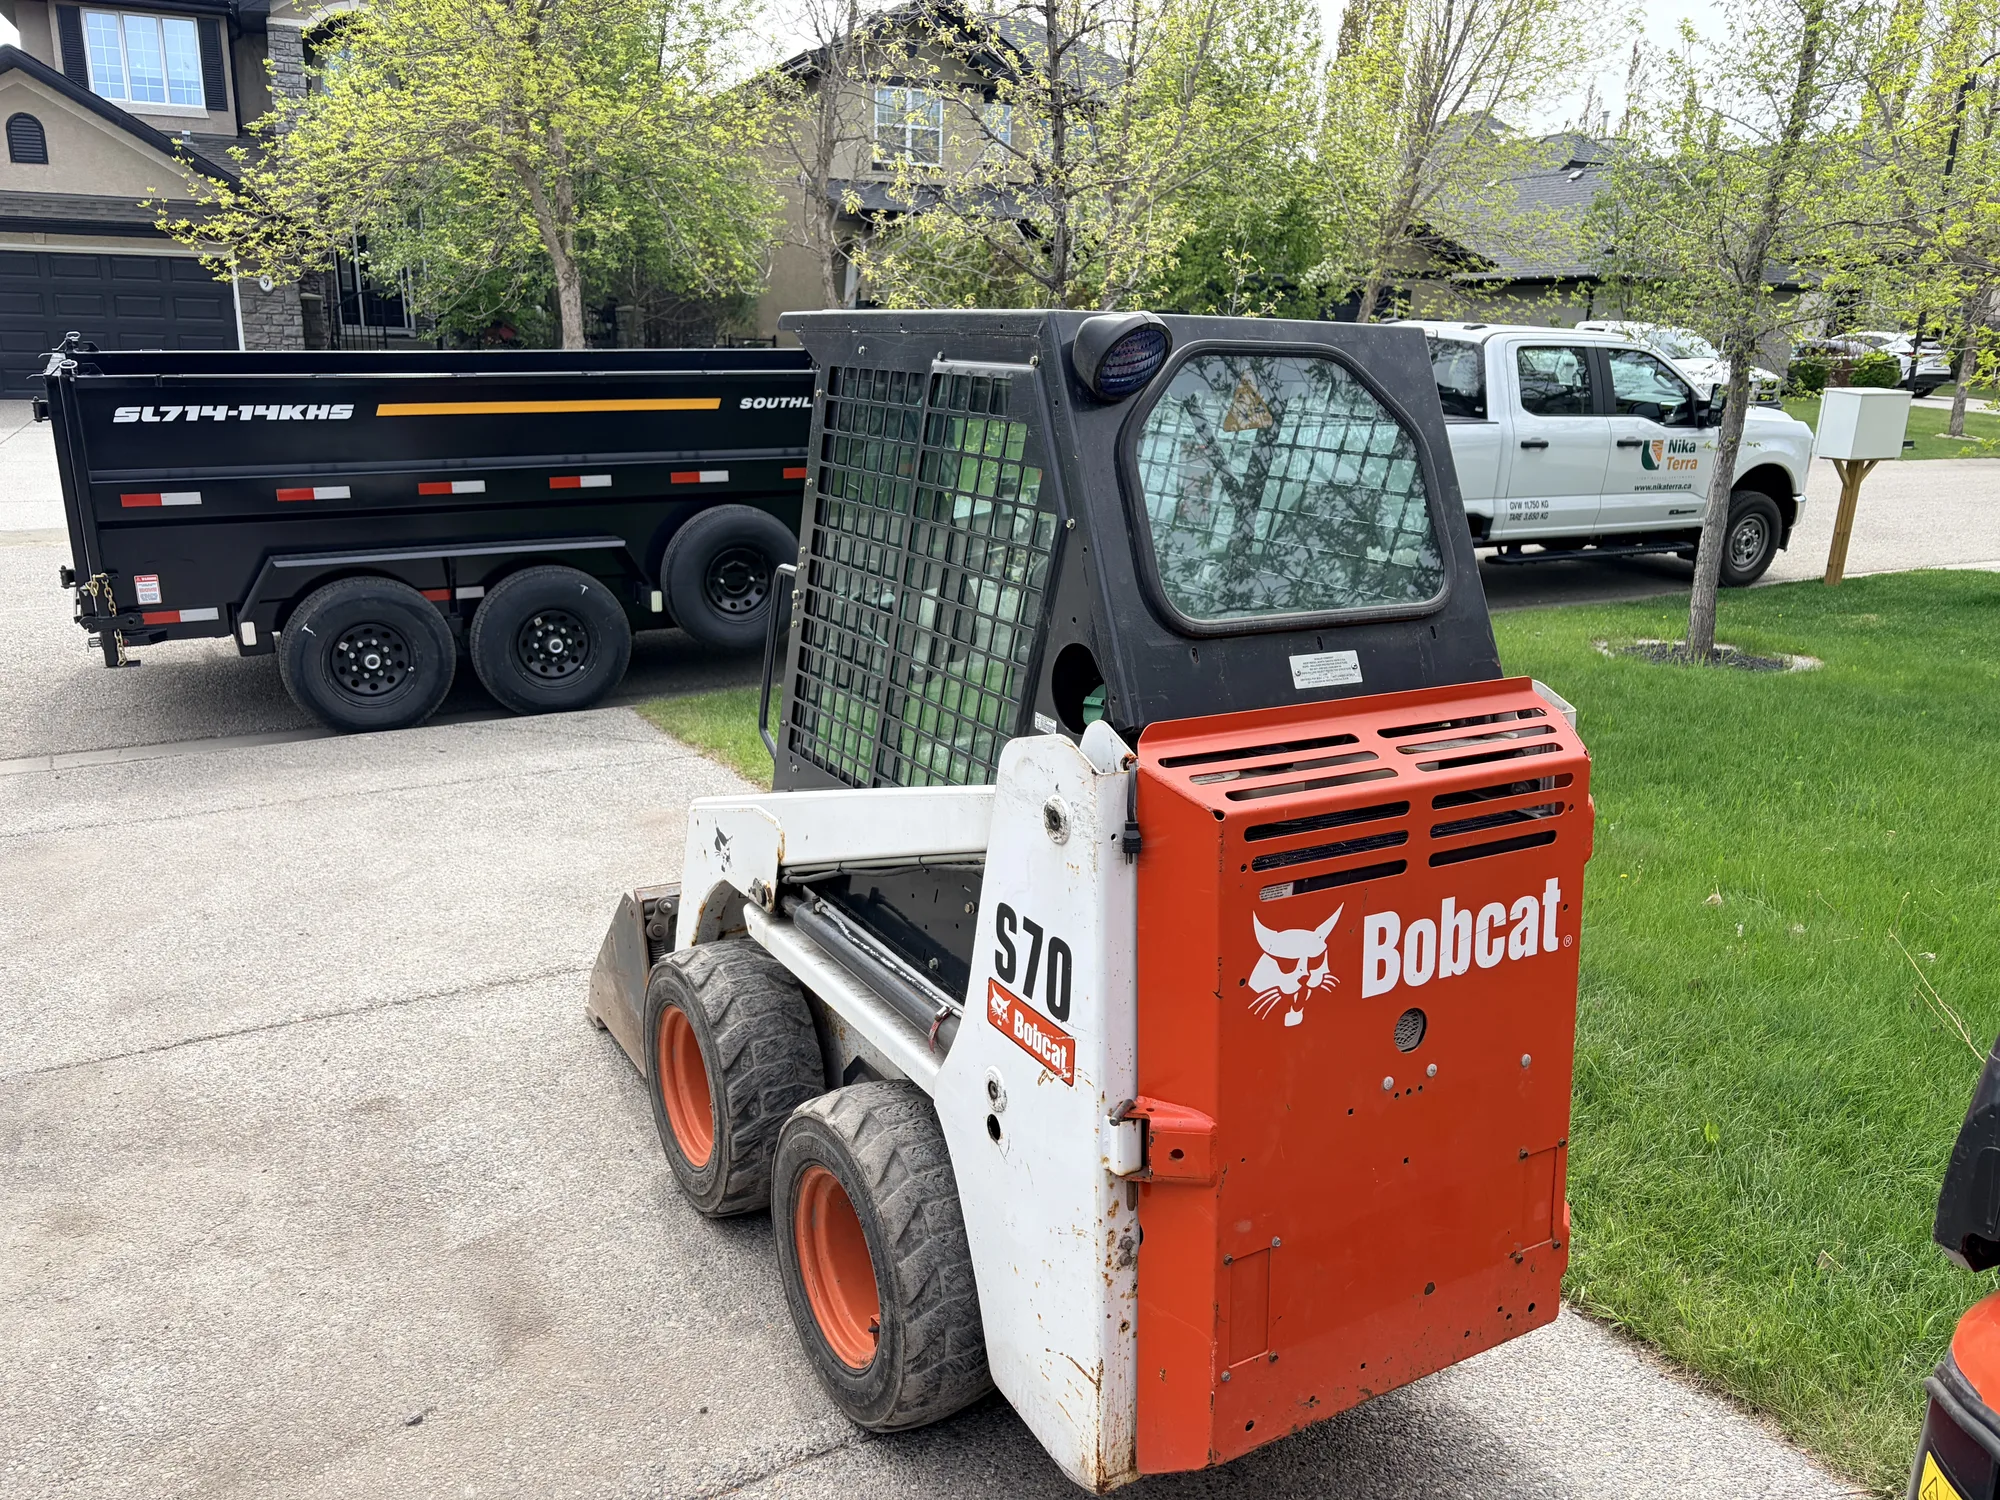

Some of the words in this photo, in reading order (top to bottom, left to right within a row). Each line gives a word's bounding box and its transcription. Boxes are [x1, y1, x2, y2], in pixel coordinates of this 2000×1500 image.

[263, 278, 269, 288] 9
[740, 397, 814, 409] SOUTHL
[113, 404, 354, 423] SL714-14KHS
[1668, 439, 1696, 453] Nika
[1667, 456, 1698, 471] Terra
[1634, 483, 1692, 491] www.nikaterra.ca
[1510, 501, 1522, 510] GVW
[1541, 500, 1549, 509] KG
[1509, 513, 1523, 521] TARE
[1540, 512, 1549, 520] KG
[1361, 877, 1561, 999] Bobcat
[994, 902, 1073, 1023] S70
[1013, 1008, 1067, 1072] Bobcat
